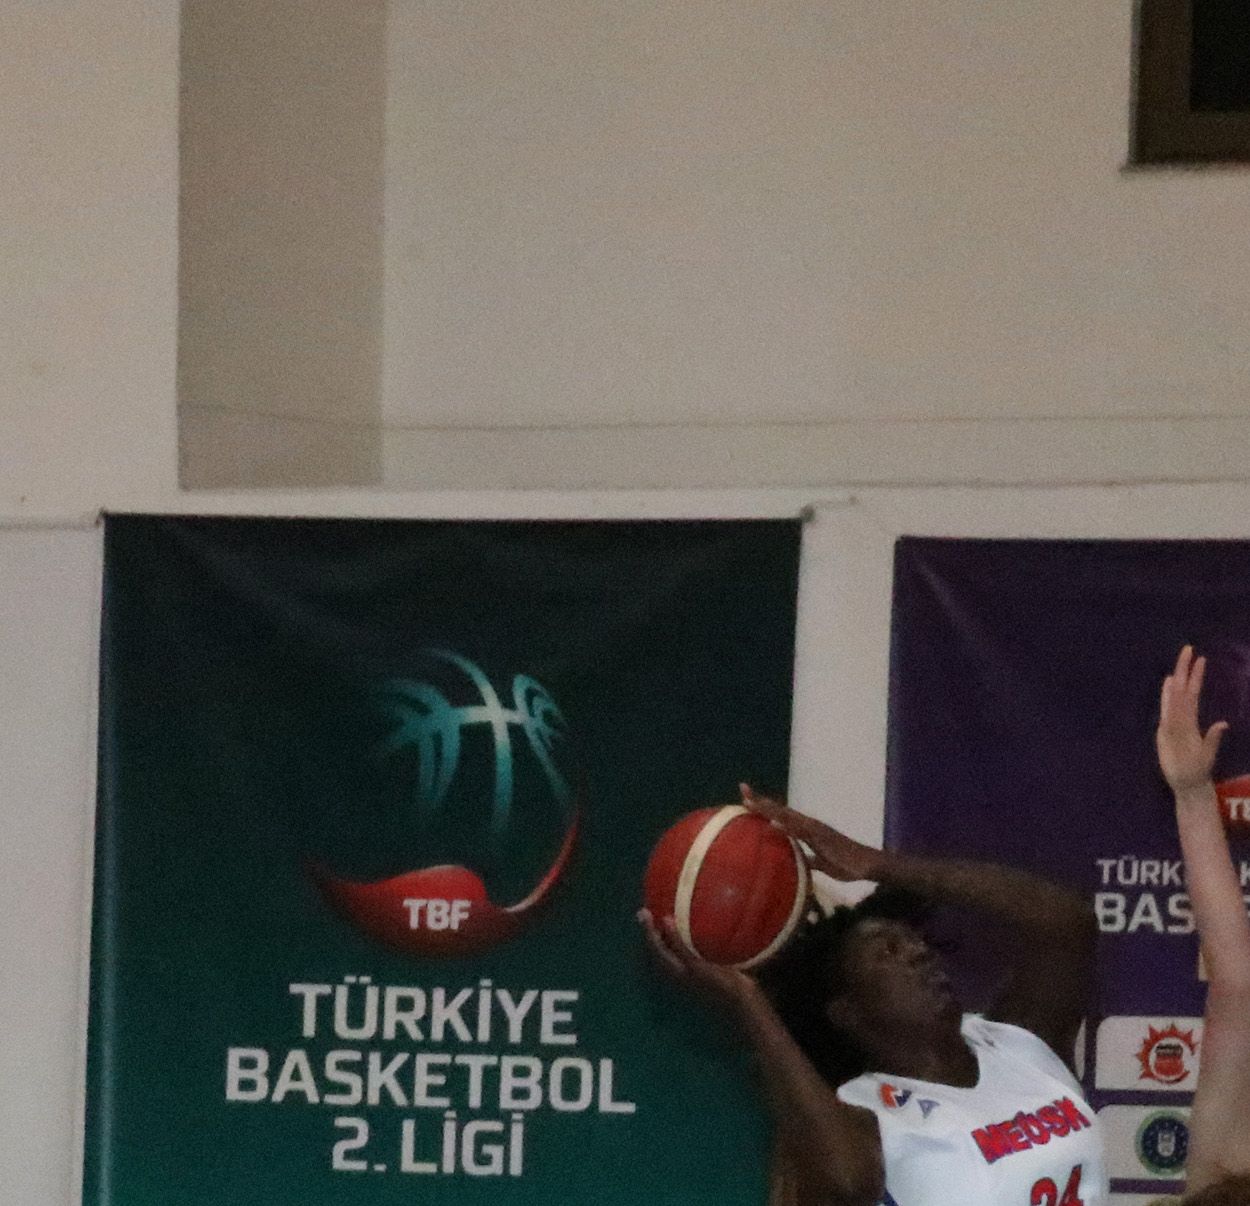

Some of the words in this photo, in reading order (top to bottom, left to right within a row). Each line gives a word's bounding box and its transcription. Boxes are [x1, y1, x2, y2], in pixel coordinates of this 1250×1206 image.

[1096, 855, 1185, 886] TÜRK
[402, 898, 471, 931] TBF
[289, 975, 580, 1045] TÜRKİYE
[224, 1047, 637, 1114] BASKETBOL
[331, 1117, 387, 1173] 2.
[401, 1110, 525, 1177] LİGİ
